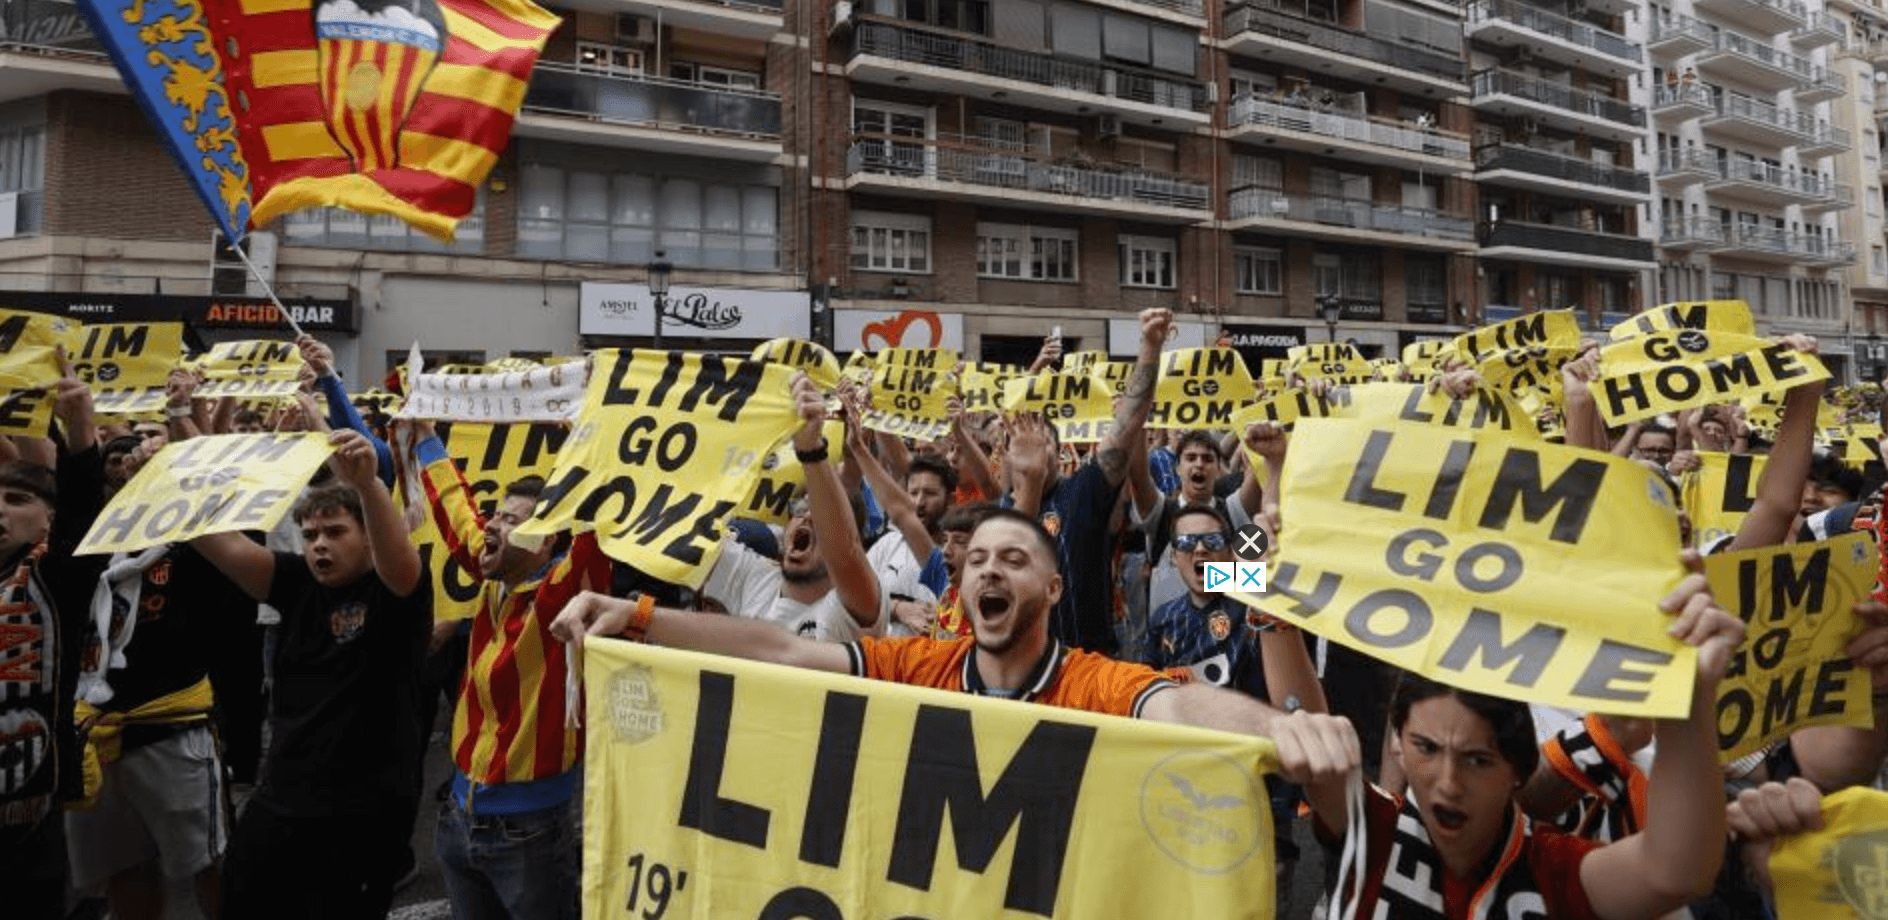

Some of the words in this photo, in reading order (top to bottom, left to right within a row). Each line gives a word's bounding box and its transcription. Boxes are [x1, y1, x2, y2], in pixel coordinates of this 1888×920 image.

[69, 305, 114, 313] MORITZ
[291, 307, 334, 324] BAR
[684, 293, 743, 324] Palco
[225, 342, 293, 363] LIM
[1251, 335, 1298, 347] PAGODA
[1308, 345, 1353, 361] LIM
[1644, 331, 1709, 362] GO
[1166, 350, 1235, 378] LIM
[602, 348, 764, 423] LIM
[881, 366, 937, 395] LIM
[1026, 376, 1089, 400] LIM
[1603, 346, 1807, 416] HOME
[894, 394, 921, 411] GO
[1400, 386, 1513, 430] LIM
[618, 415, 698, 473] GO
[1343, 430, 1608, 545] LIM
[88, 489, 289, 546] HOME
[1385, 528, 1524, 593] GO
[1739, 547, 1831, 624] IM
[1715, 657, 1855, 750] OME
[678, 669, 1098, 919] LIM
